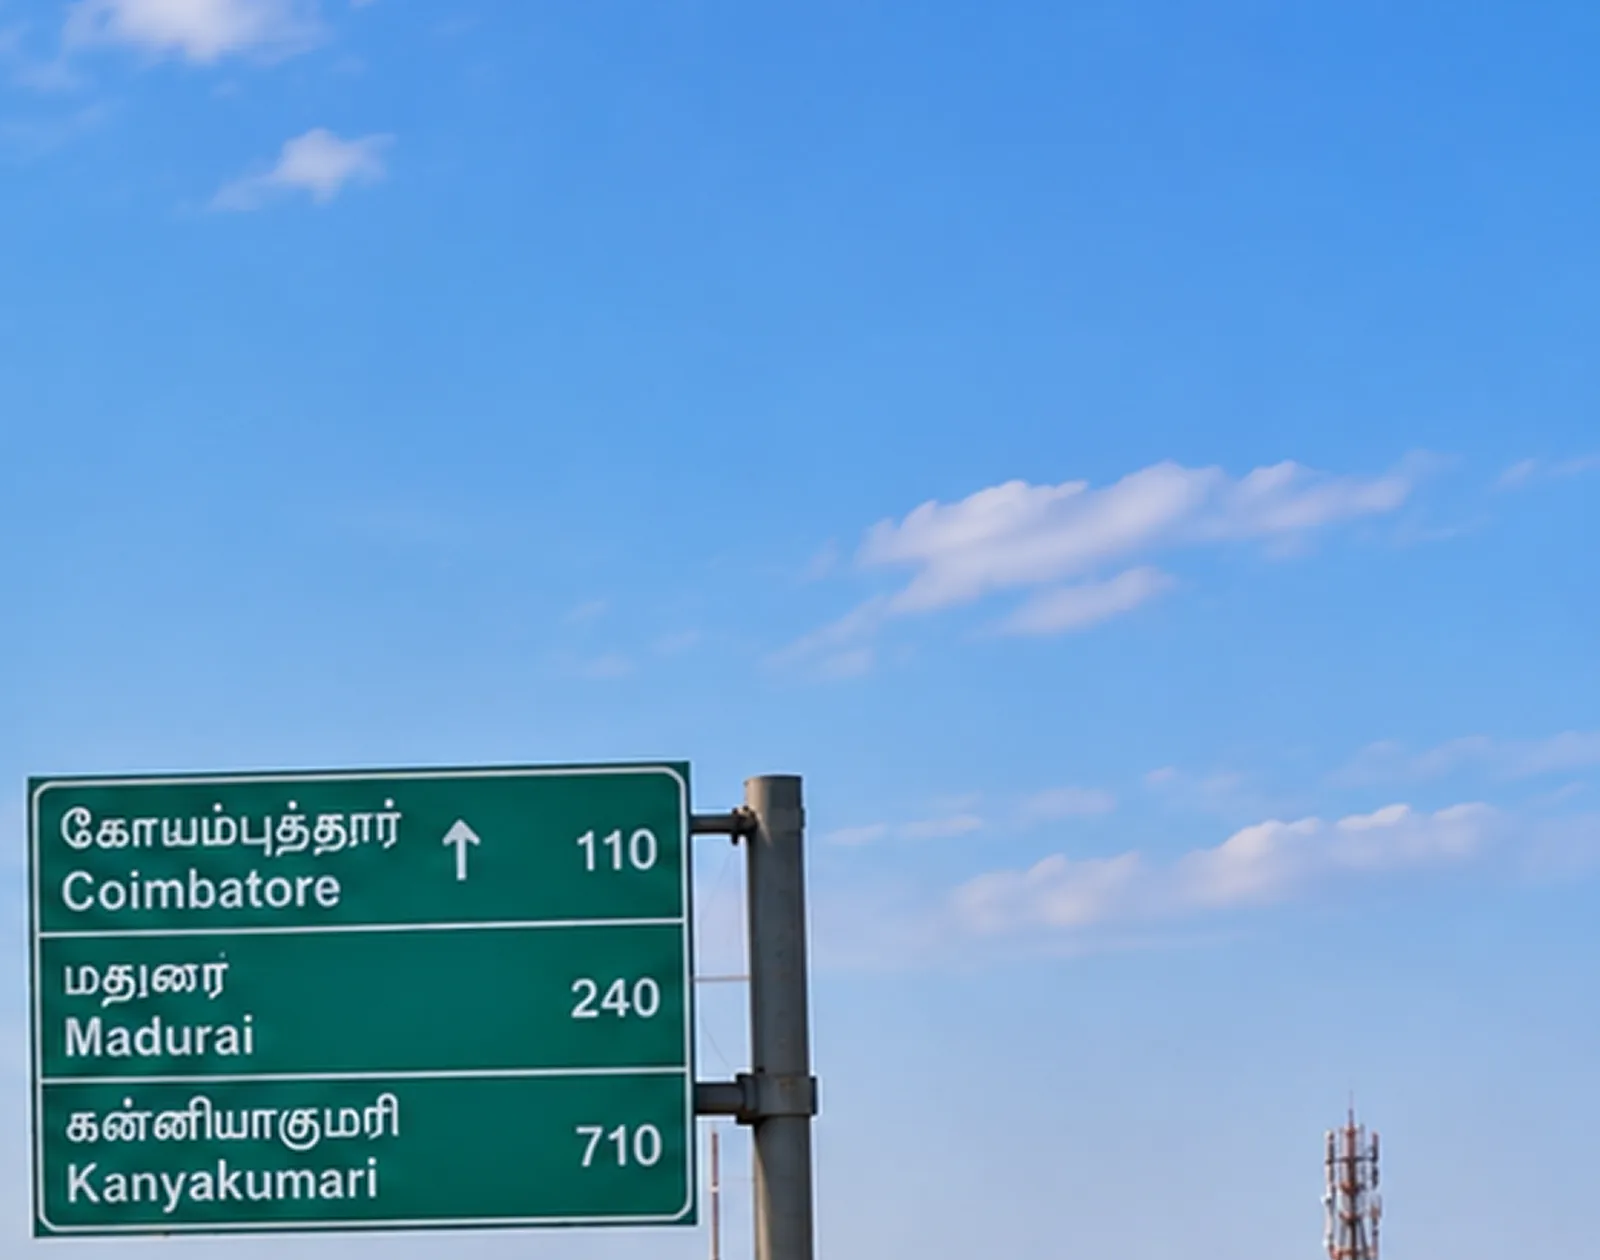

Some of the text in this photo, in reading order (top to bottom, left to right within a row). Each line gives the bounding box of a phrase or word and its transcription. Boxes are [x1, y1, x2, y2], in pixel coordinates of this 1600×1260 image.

[577, 828, 657, 871] 110
[62, 868, 341, 911] Coimbatore
[571, 977, 660, 1018] 240
[65, 1014, 253, 1057] Madurai
[66, 1092, 399, 1151] கன்னியாகுமரி
[576, 1124, 662, 1167] 710
[68, 1156, 377, 1214] Kanyakumari
